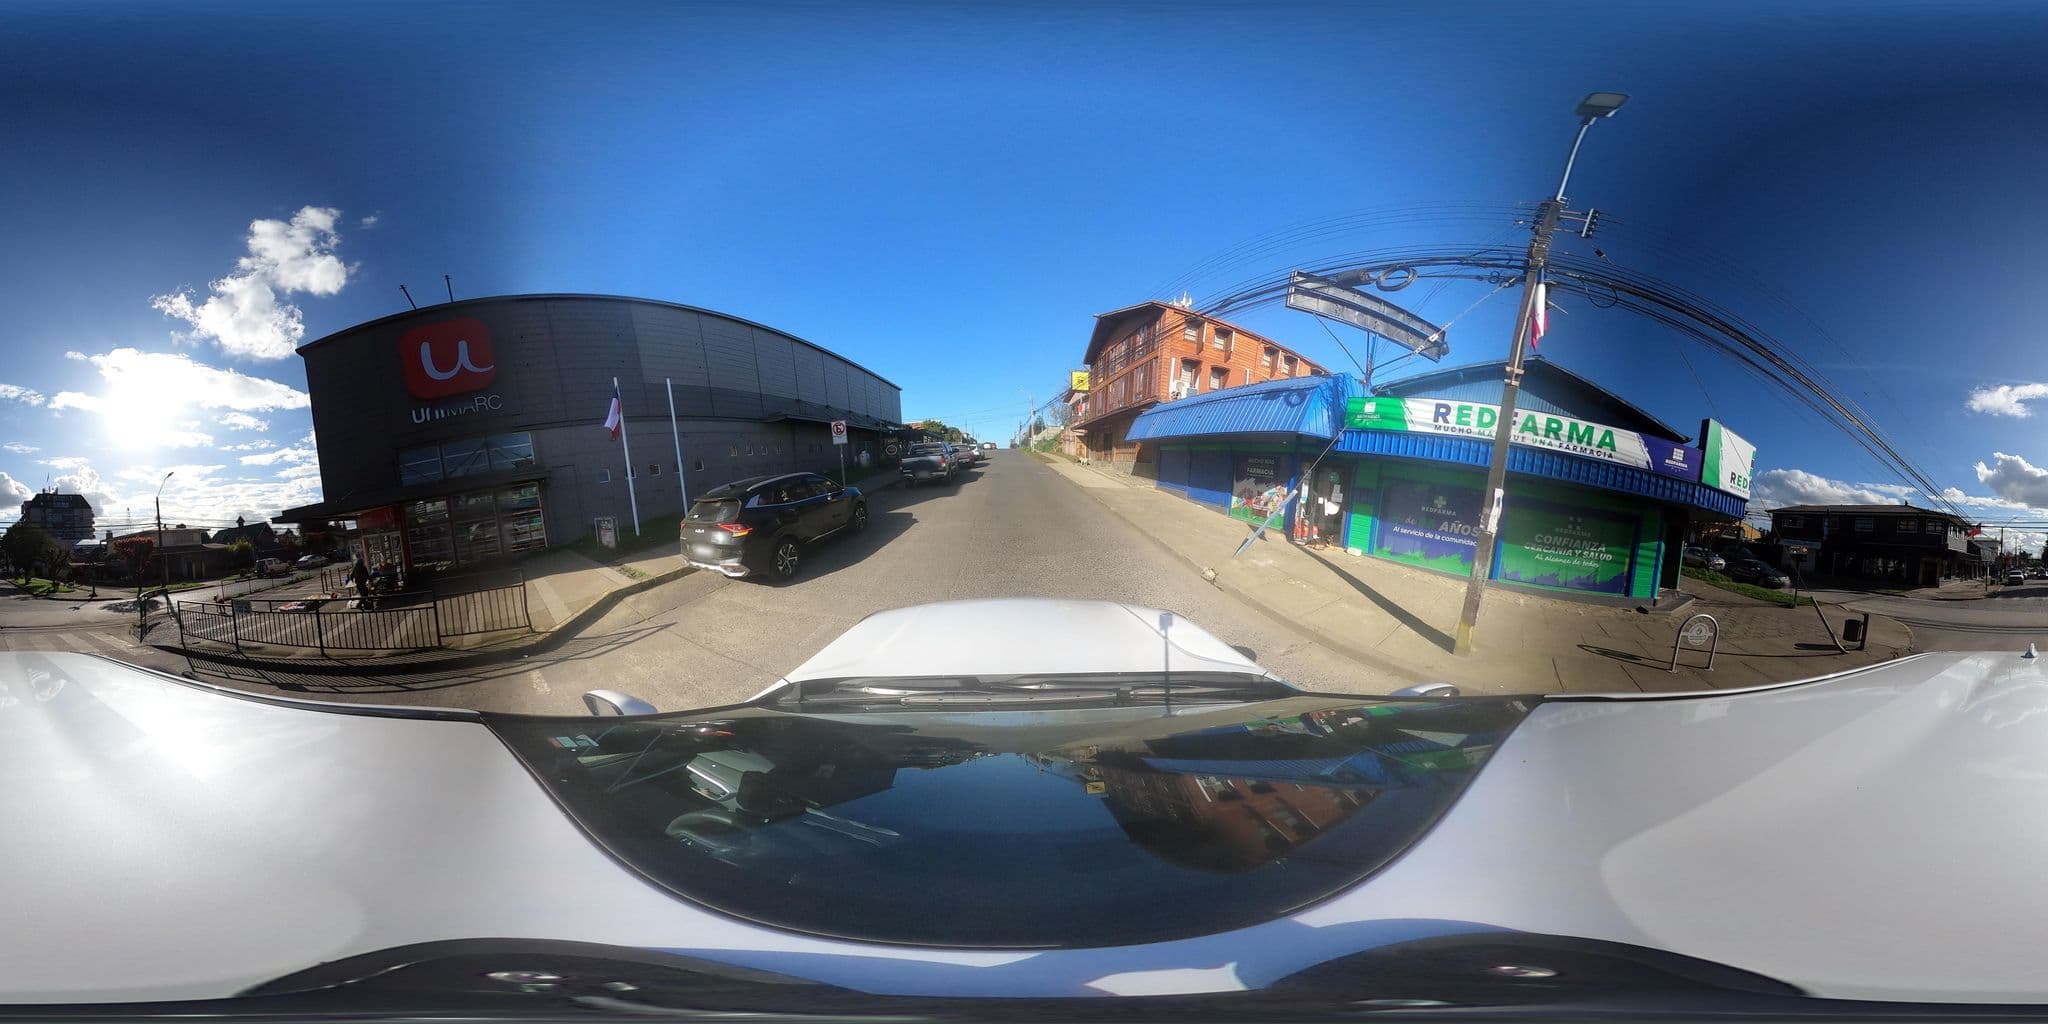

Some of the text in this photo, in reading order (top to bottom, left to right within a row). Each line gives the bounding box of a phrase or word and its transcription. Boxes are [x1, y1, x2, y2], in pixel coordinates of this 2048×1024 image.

[1434, 424, 1472, 435] MUCHO
[1531, 437, 1554, 448] UNA
[1558, 442, 1614, 459] FARMACIA
[1400, 528, 1425, 538] servicio
[1439, 520, 1480, 538] AÑOS
[1535, 533, 1606, 552] CONFIANZA
[1582, 551, 1613, 562] SALUD
